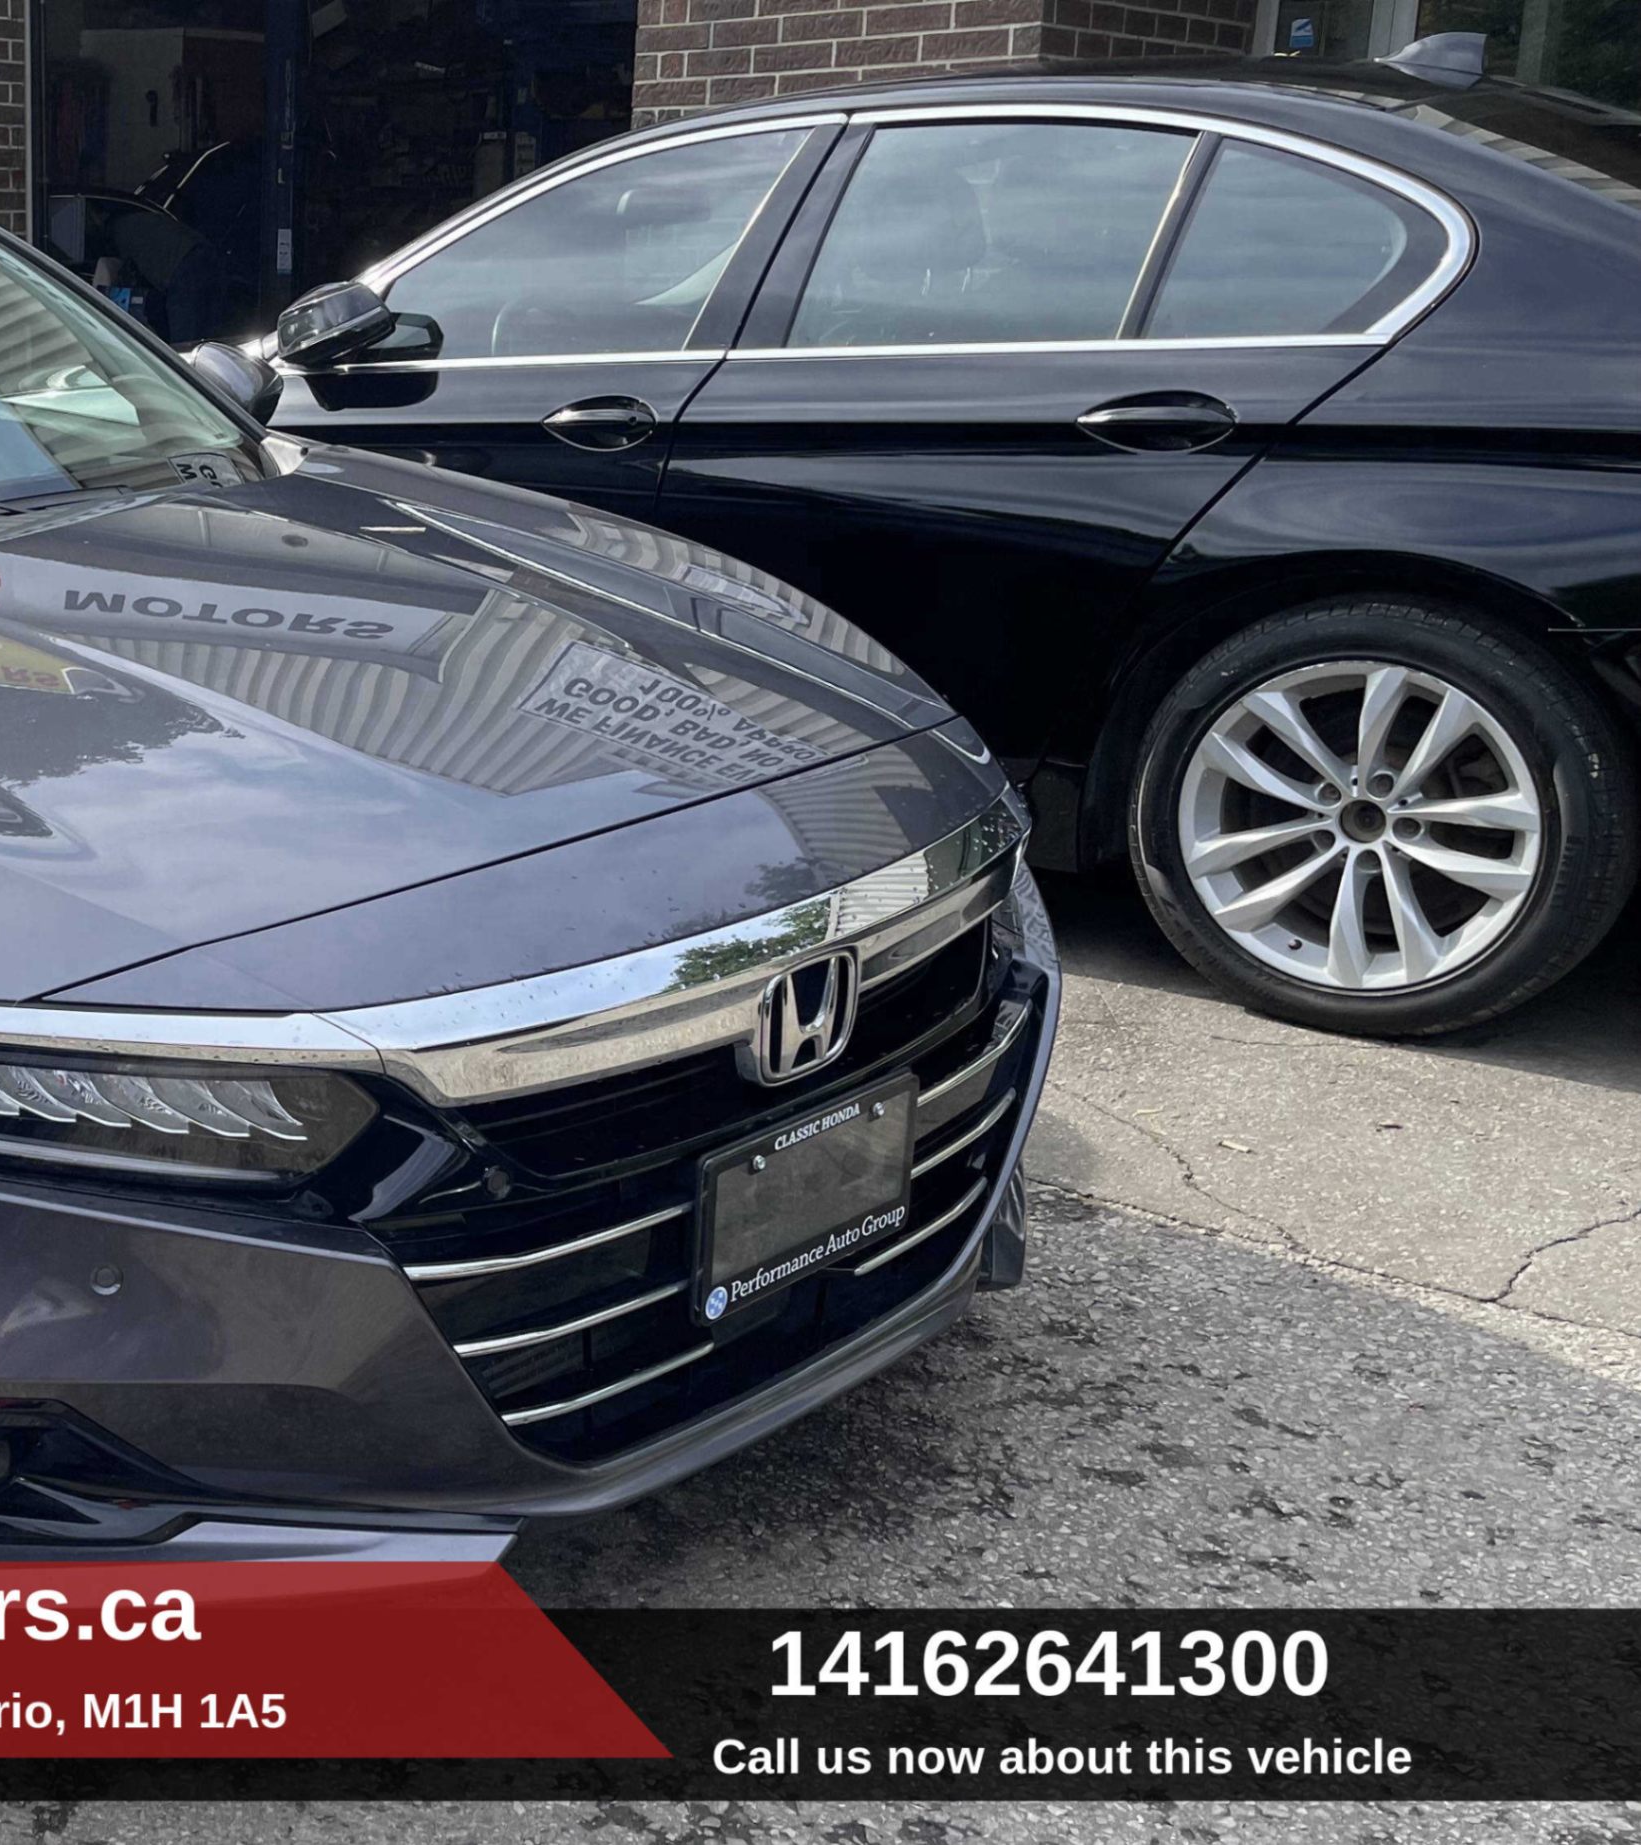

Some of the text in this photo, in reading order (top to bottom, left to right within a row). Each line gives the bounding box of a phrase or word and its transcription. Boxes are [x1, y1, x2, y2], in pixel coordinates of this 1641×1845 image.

[774, 1103, 861, 1151] CLASSIC HONDA
[730, 1205, 906, 1303] Performance Auto Group
